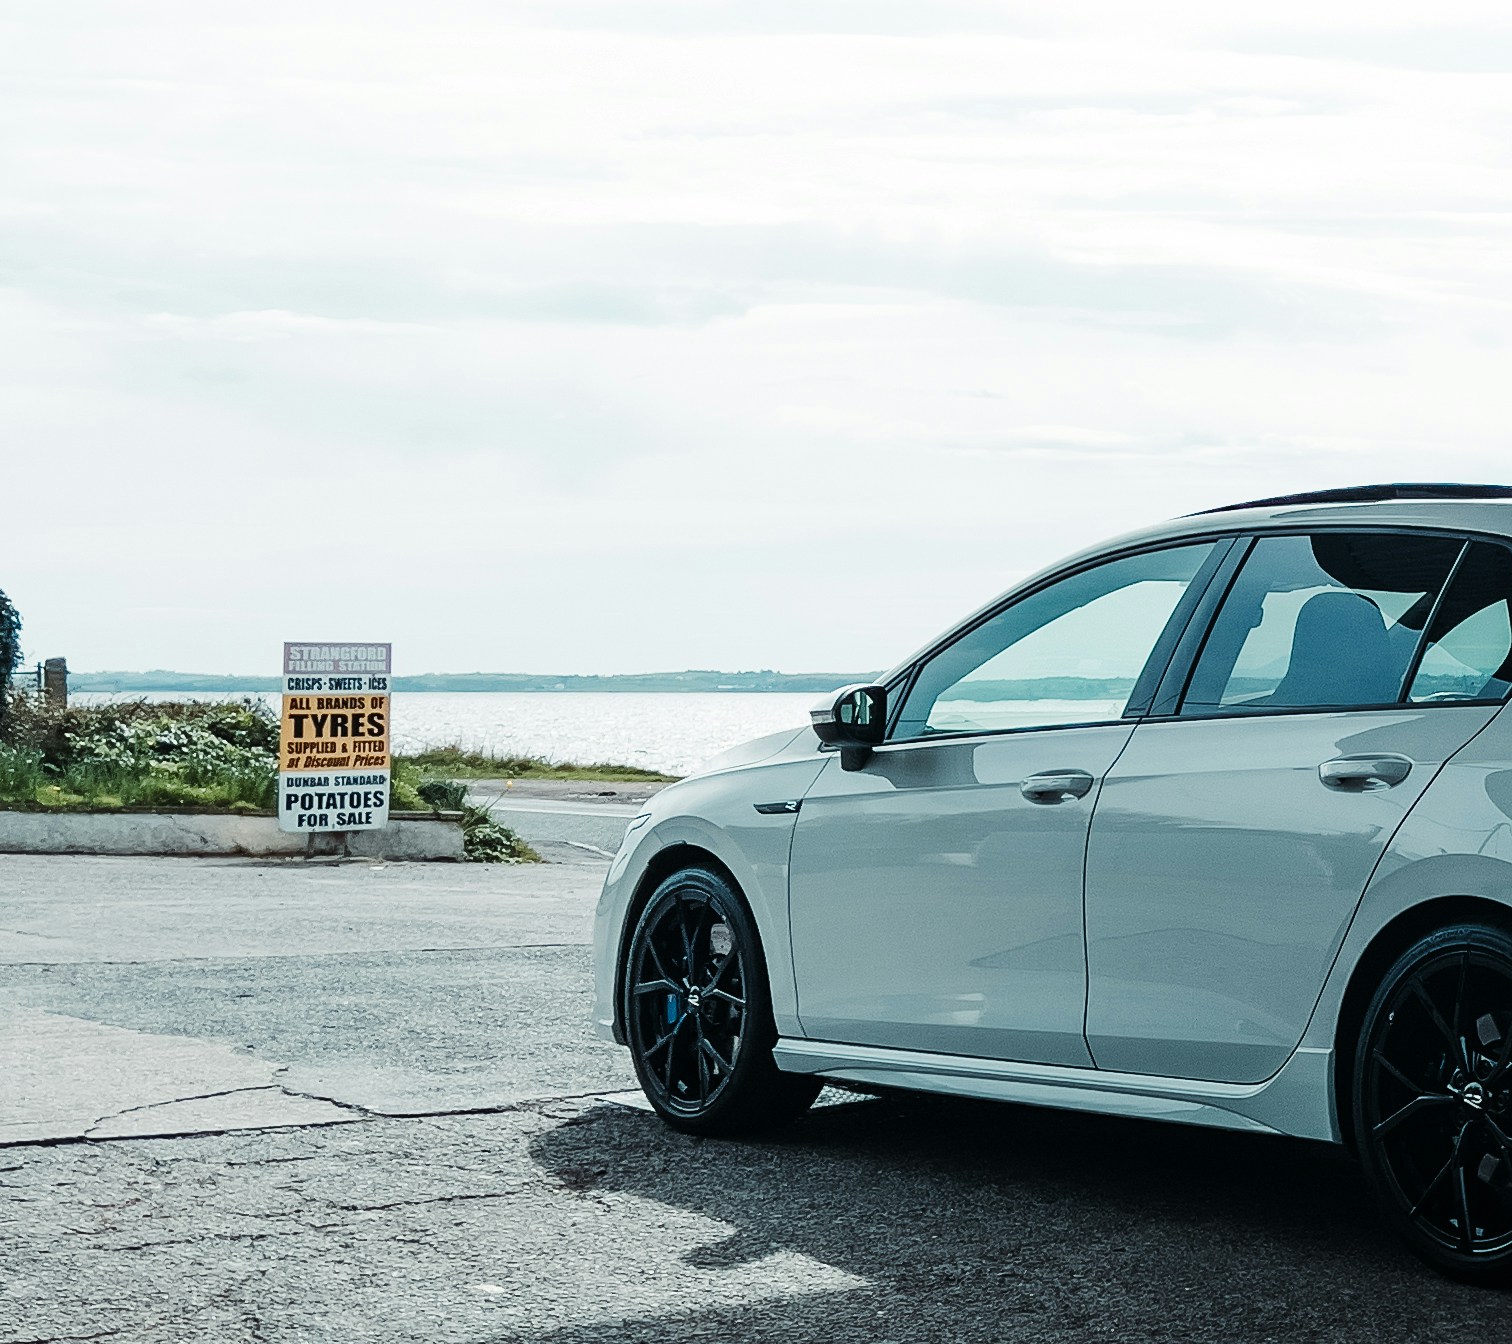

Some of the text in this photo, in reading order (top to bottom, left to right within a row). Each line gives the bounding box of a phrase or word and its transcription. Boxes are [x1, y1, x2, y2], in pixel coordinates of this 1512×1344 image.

[290, 646, 386, 660] STRANGFORD
[288, 660, 386, 671] FILLING STATION
[287, 676, 388, 691] CRISPS SWEETS ICES
[290, 697, 385, 710] ALL BRANDS OF
[288, 712, 385, 738] TYRES
[287, 740, 385, 754] SUPPLIED & FITTED
[287, 754, 386, 768] at Discount Prices
[286, 775, 386, 787] DUNBAR STANDARD
[286, 791, 385, 810] POTATOES
[298, 811, 373, 827] FOR SALE
